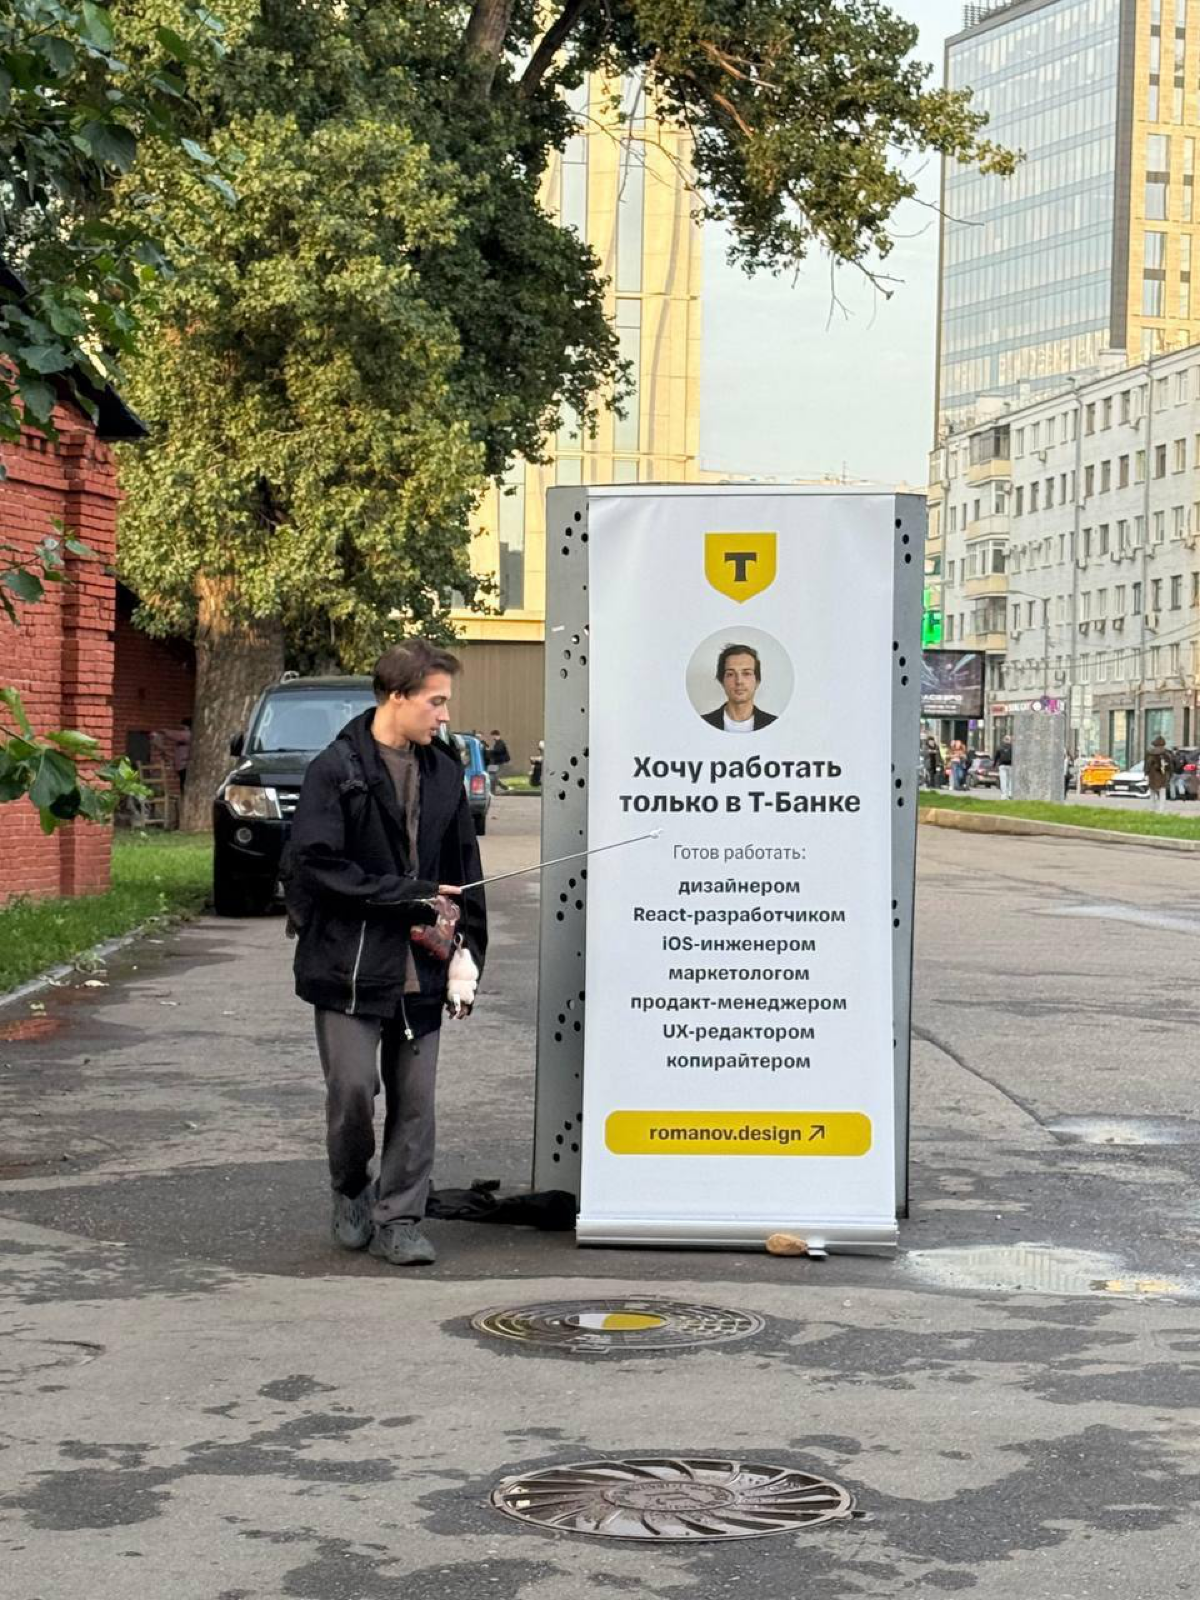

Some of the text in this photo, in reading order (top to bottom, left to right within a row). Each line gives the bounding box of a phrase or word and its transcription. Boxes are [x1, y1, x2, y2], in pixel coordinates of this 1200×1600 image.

[633, 755, 842, 783] Хочу работать
[619, 791, 861, 813] только в Т-Банке
[673, 844, 806, 862] Готов работать:
[678, 878, 800, 896] дизайнером
[633, 906, 846, 926] React-разработчиком
[662, 935, 816, 955] iOS-инженером
[668, 967, 810, 984] маркетологом
[630, 996, 847, 1014] продакт-менеджером
[663, 1023, 815, 1043] UX-редактором
[666, 1053, 811, 1071] копирайтером
[649, 1125, 802, 1145] romanov.design
